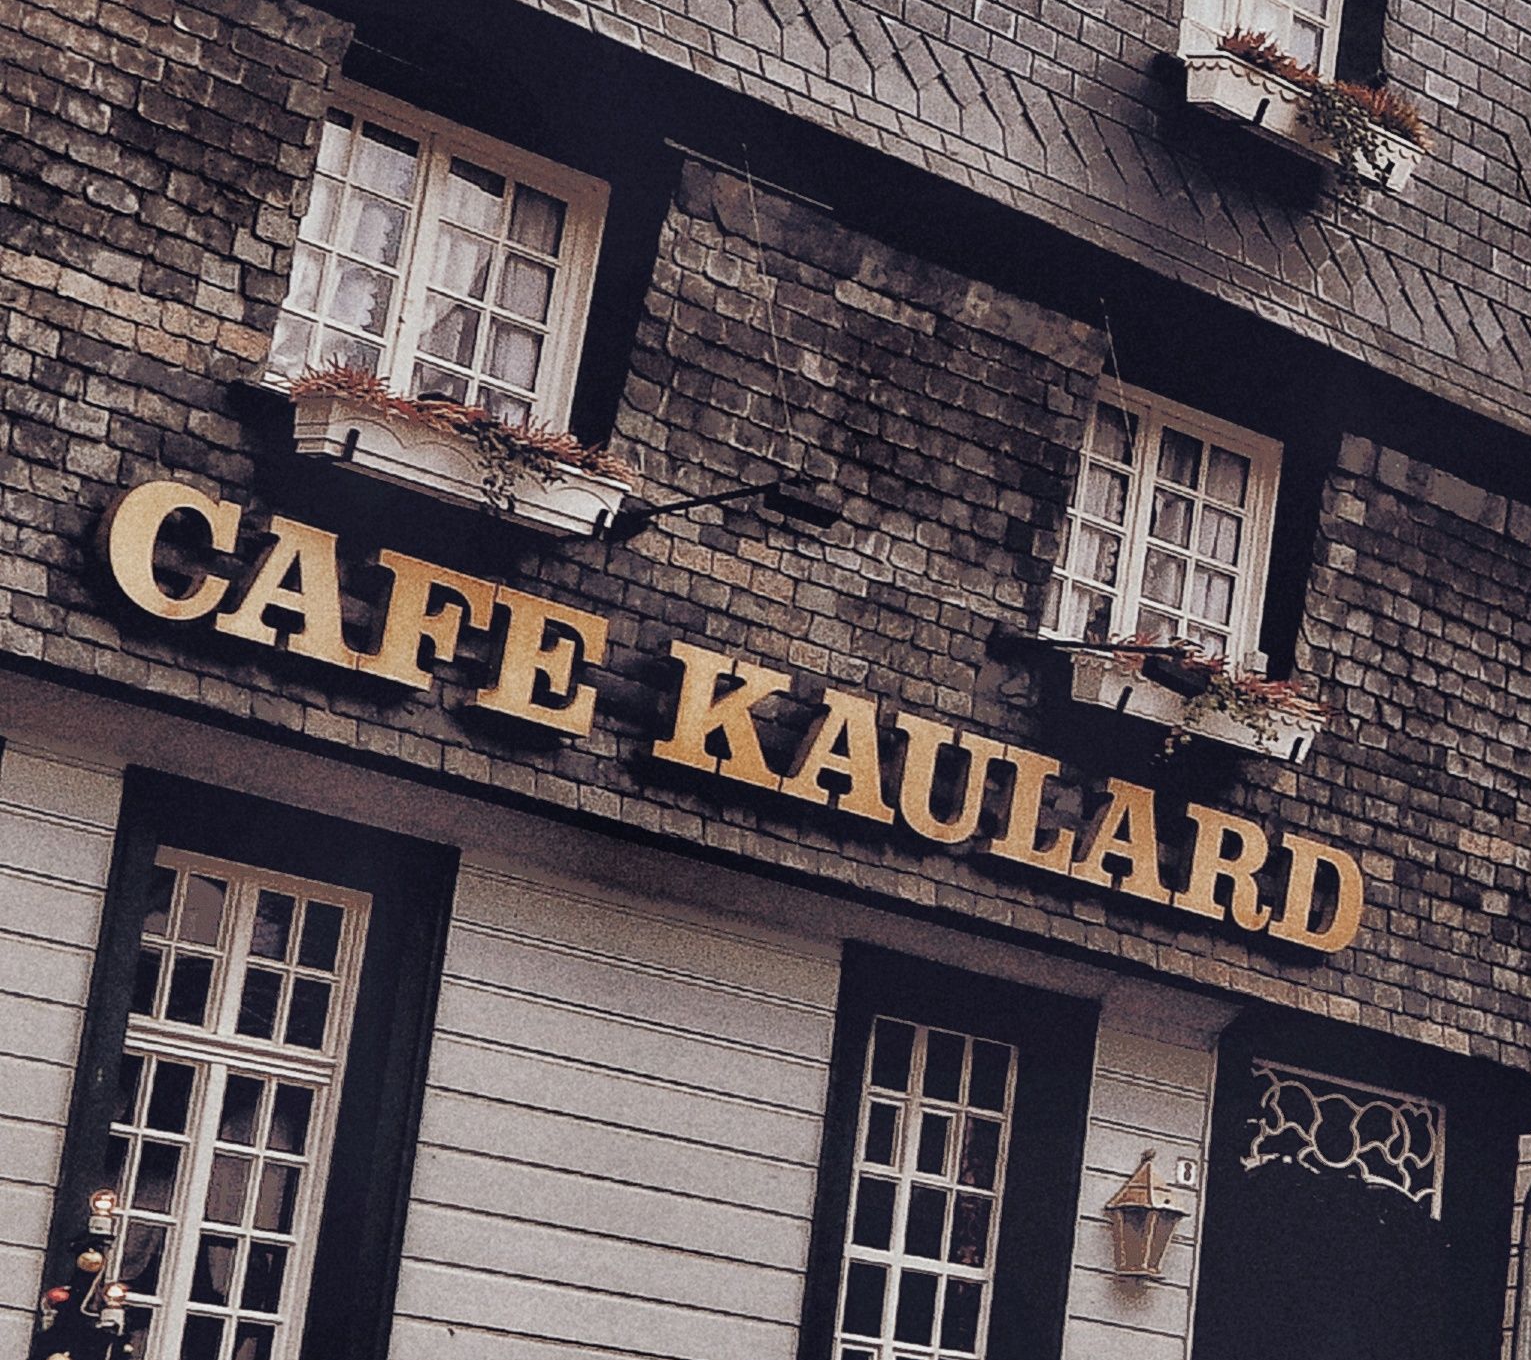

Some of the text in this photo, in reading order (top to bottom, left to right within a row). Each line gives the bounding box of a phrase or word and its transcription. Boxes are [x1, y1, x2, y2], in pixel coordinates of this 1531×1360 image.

[109, 480, 1366, 953] CAFE KAULARD
[1184, 1162, 1193, 1182] 8
